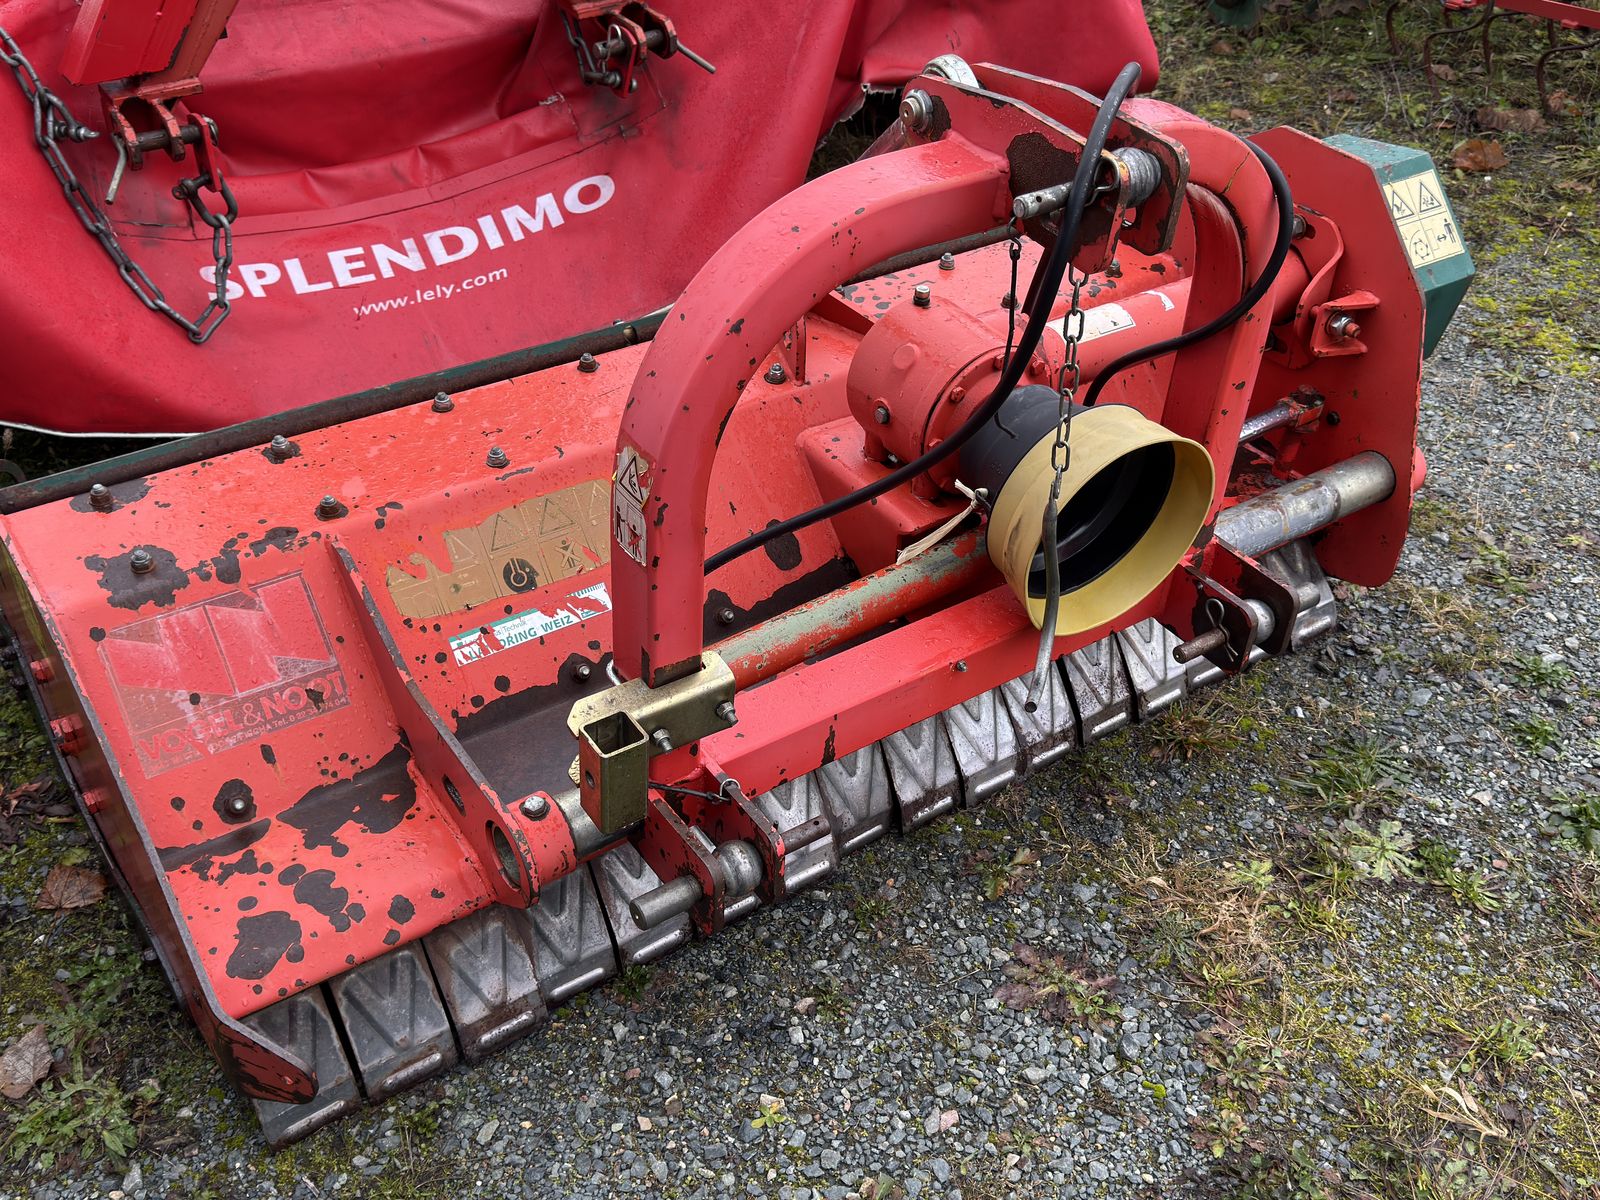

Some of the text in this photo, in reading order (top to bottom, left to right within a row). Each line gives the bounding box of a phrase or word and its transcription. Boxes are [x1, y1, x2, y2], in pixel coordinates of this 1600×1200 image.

[199, 174, 616, 303] SPLENDIMO
[353, 266, 508, 317] www.lely.com
[540, 614, 574, 633] WEIZ
